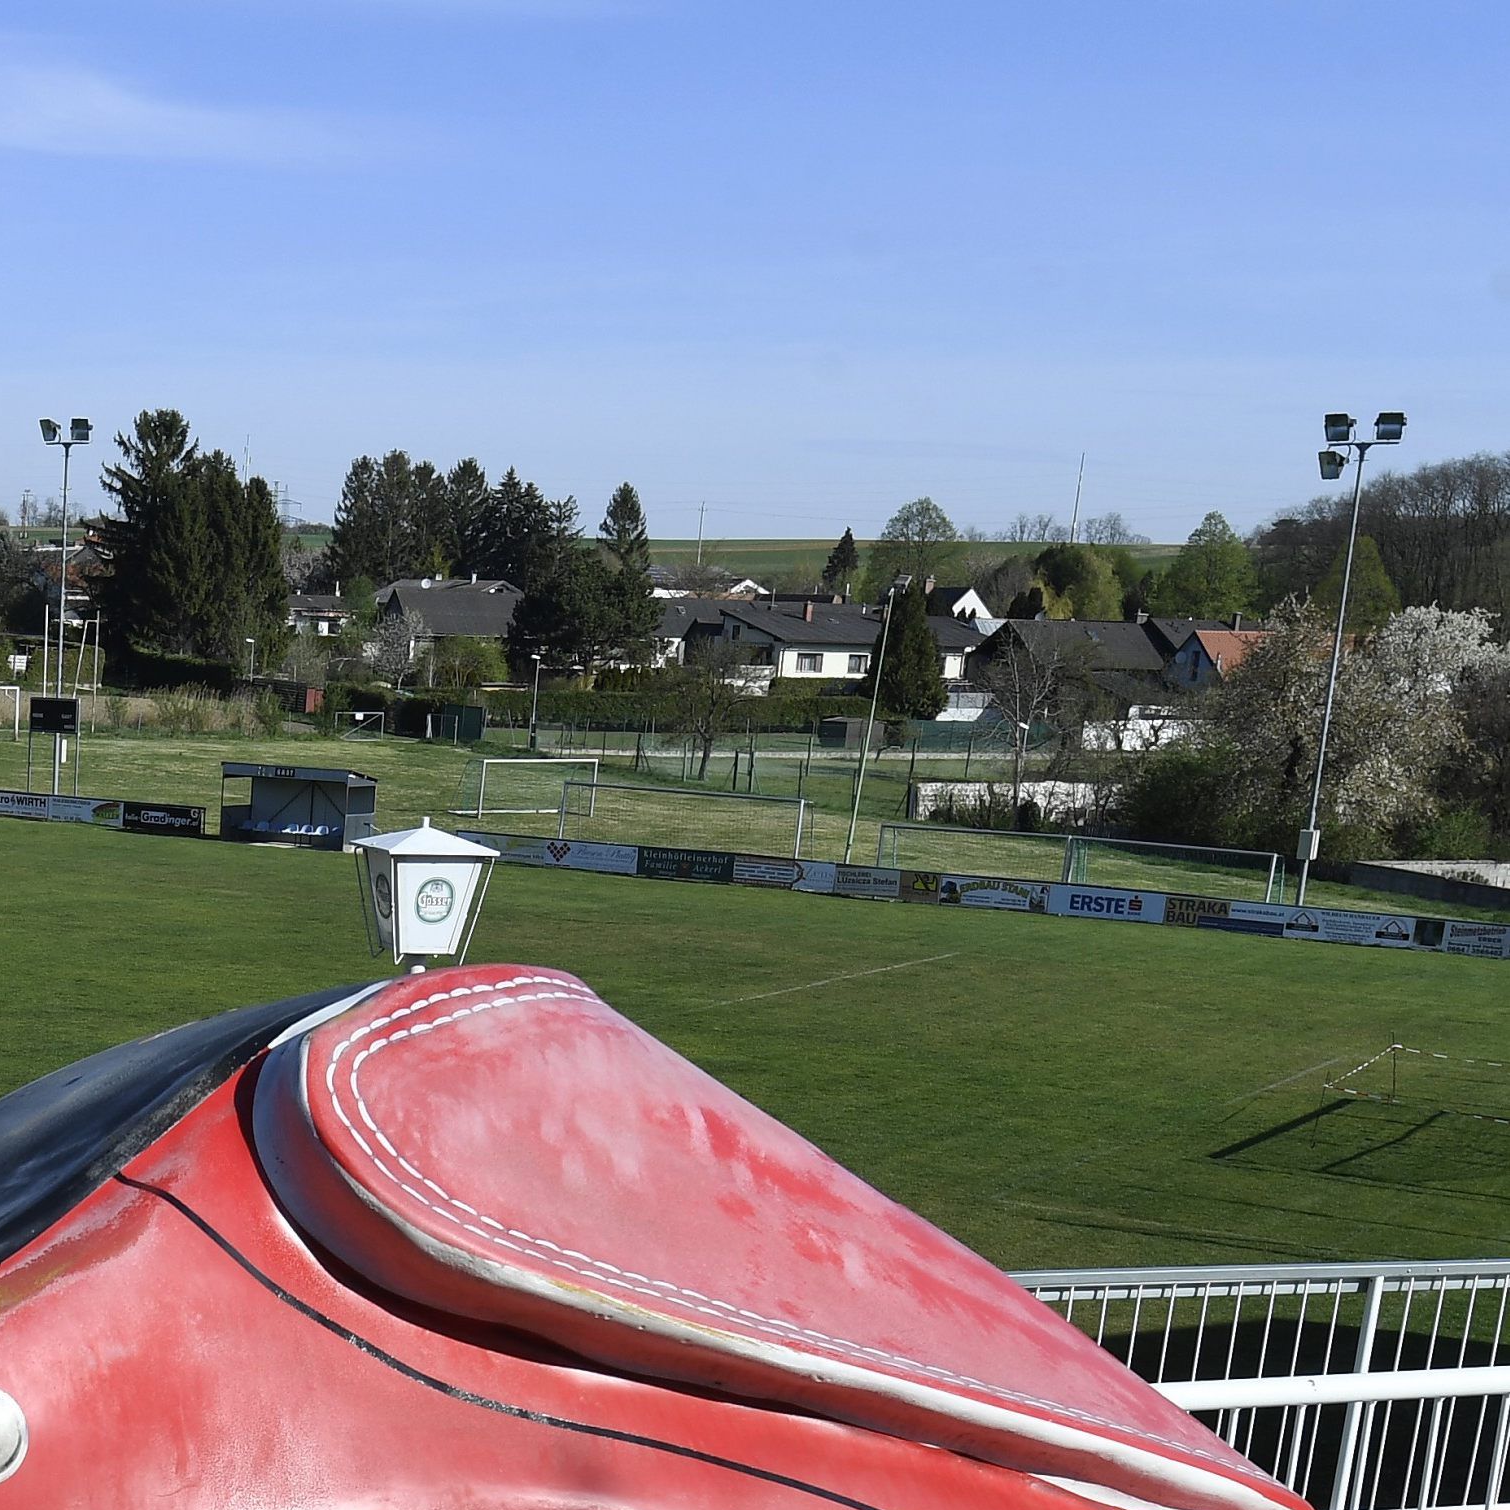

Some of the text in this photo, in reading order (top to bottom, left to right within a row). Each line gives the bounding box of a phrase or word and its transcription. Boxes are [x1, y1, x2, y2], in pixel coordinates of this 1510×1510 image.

[15, 796, 47, 808] WIRTH
[644, 859, 678, 871] Familie
[872, 878, 898, 887] Stefan
[1069, 894, 1126, 915] ERSTE
[1167, 899, 1229, 916] STRAKA
[1167, 911, 1197, 925] BAU
